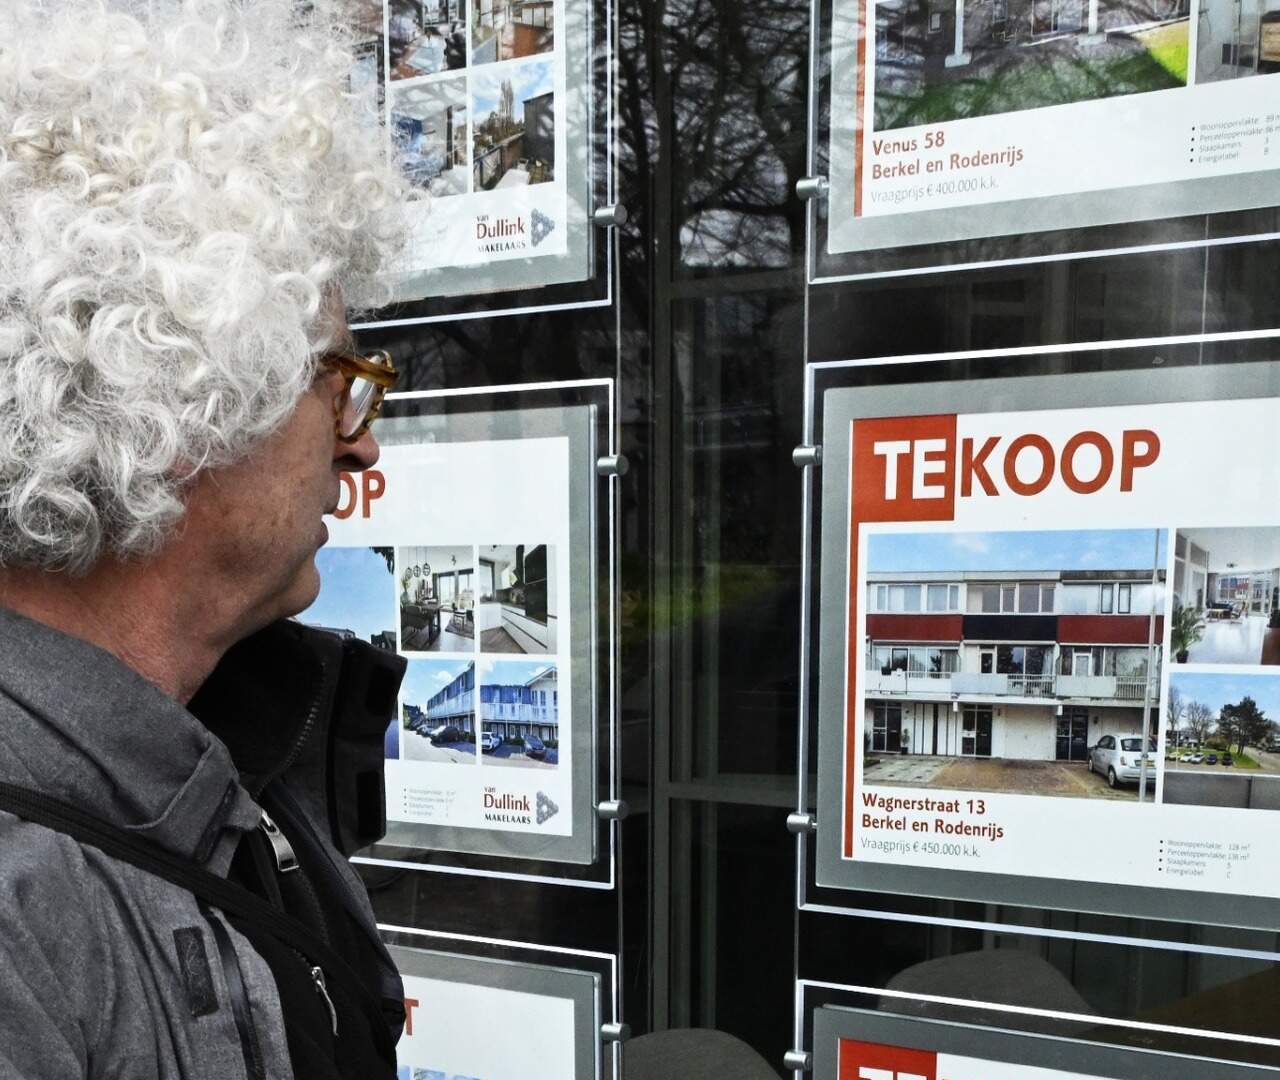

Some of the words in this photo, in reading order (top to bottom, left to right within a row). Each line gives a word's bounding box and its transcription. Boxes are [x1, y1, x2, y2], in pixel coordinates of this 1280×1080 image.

[872, 139, 918, 156] Venus
[924, 131, 945, 149] 58
[872, 160, 920, 179] Berkel
[926, 160, 943, 173] en
[950, 146, 1024, 170] Rodenrijs
[871, 186, 924, 205] Vraagprijs
[476, 216, 525, 240] Dullink
[484, 793, 530, 811] Dullink
[862, 793, 960, 813] Wagnerstraat
[966, 799, 986, 815] 13
[485, 813, 531, 824] MAKELAARS
[862, 813, 906, 831] Berkel
[912, 819, 928, 833] en
[935, 818, 1004, 842] Rodenrijs
[861, 836, 911, 854] Vraagprijs
[921, 841, 961, 857] 450.000
